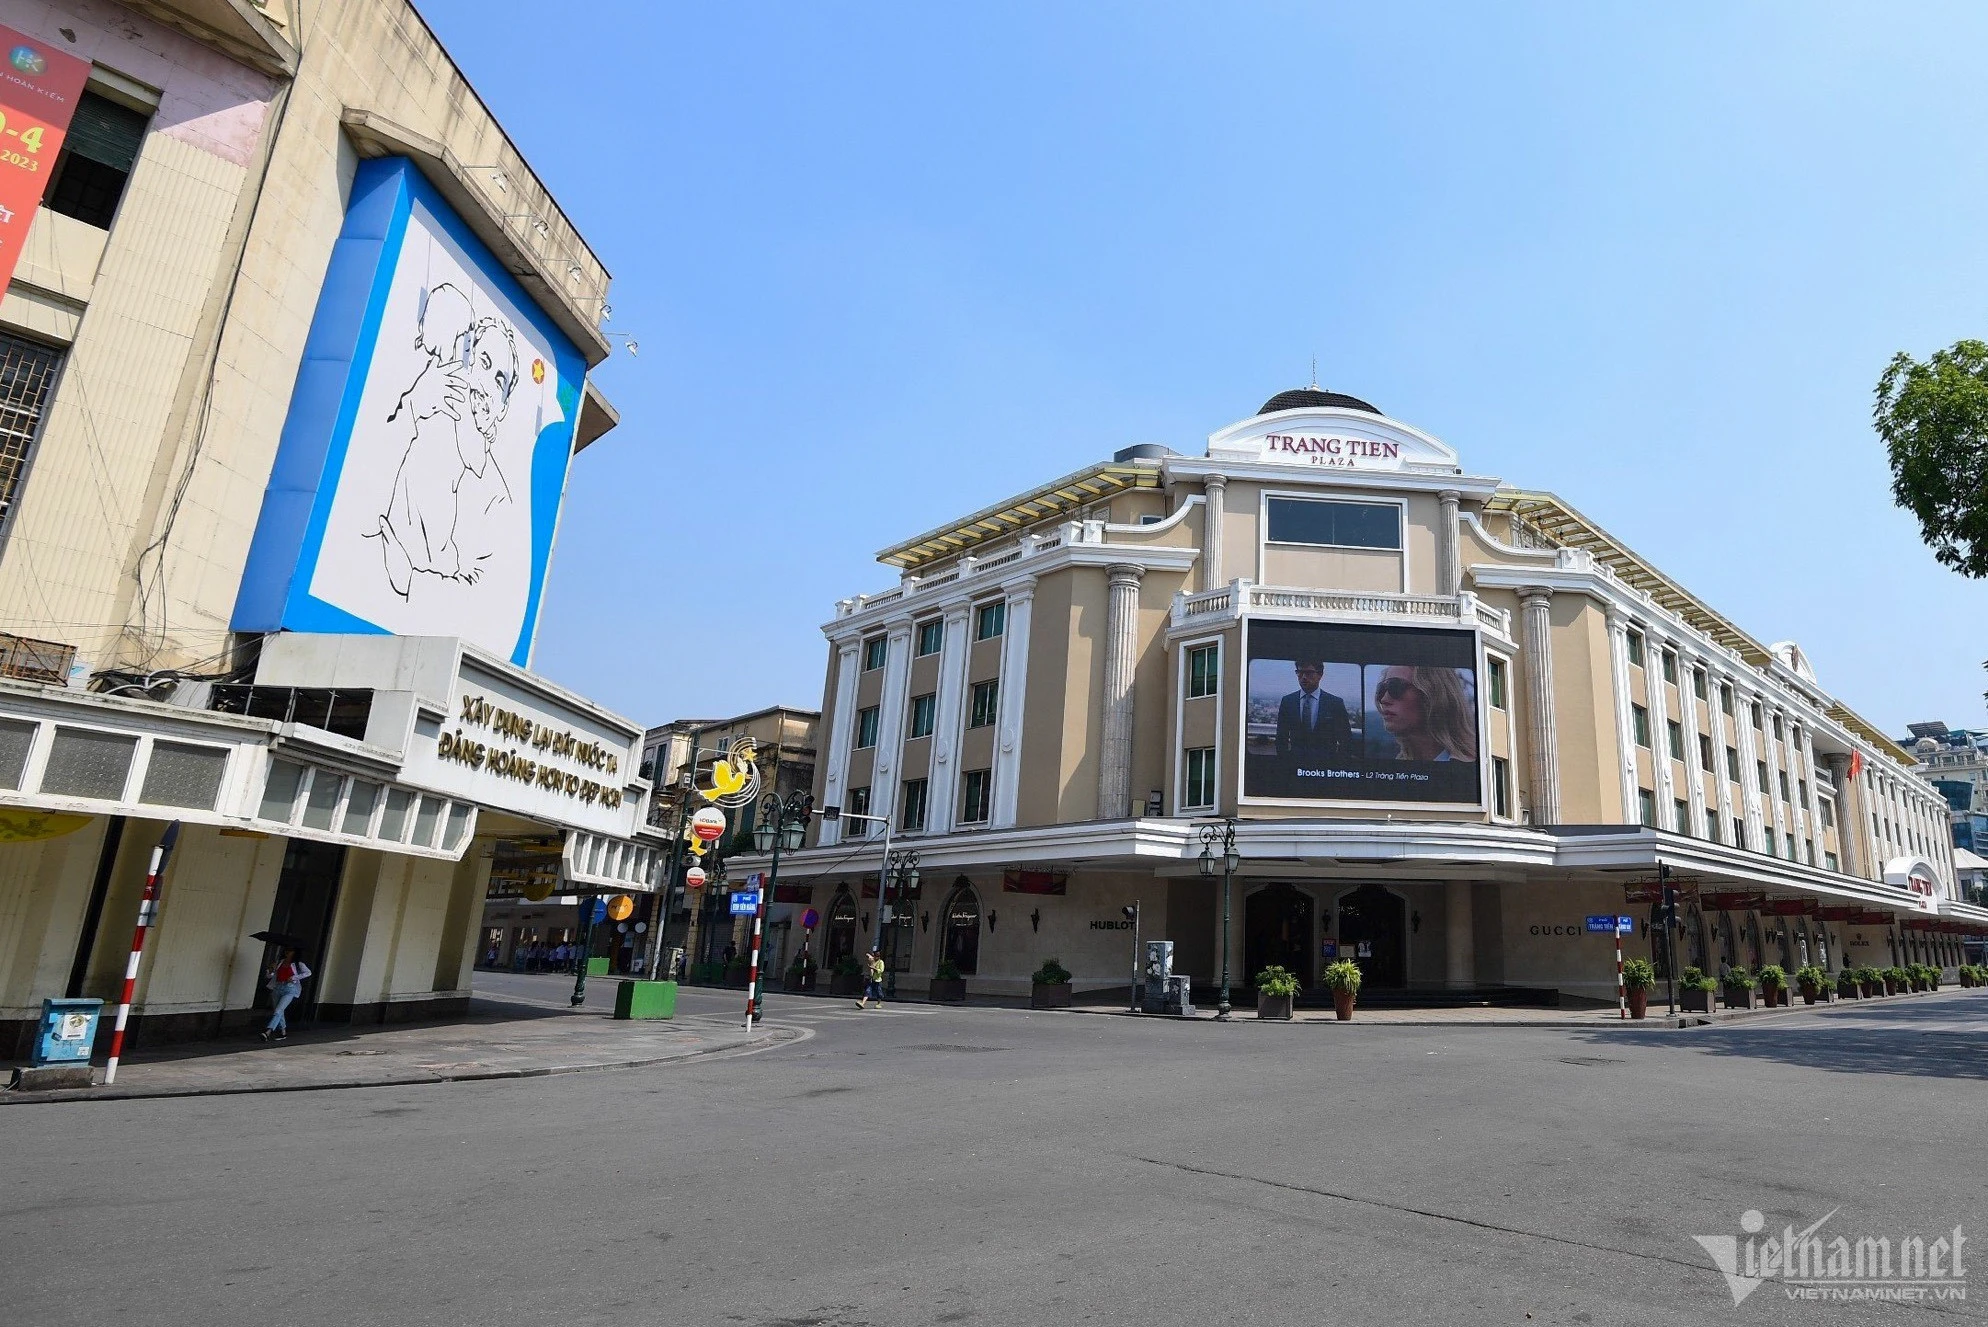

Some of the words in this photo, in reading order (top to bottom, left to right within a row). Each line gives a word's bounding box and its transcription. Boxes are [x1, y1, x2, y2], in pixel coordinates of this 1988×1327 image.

[1, 149, 38, 172] 2023
[1266, 435, 1342, 454] TRANG
[1346, 440, 1399, 458] TIEN
[1311, 456, 1355, 467] PLAZA
[1297, 768, 1325, 777] Brooks
[1327, 769, 1360, 779] Brothers
[1410, 773, 1429, 781] Plaza
[1090, 920, 1136, 930] HUBLOT
[1530, 925, 1581, 936] GUCCI
